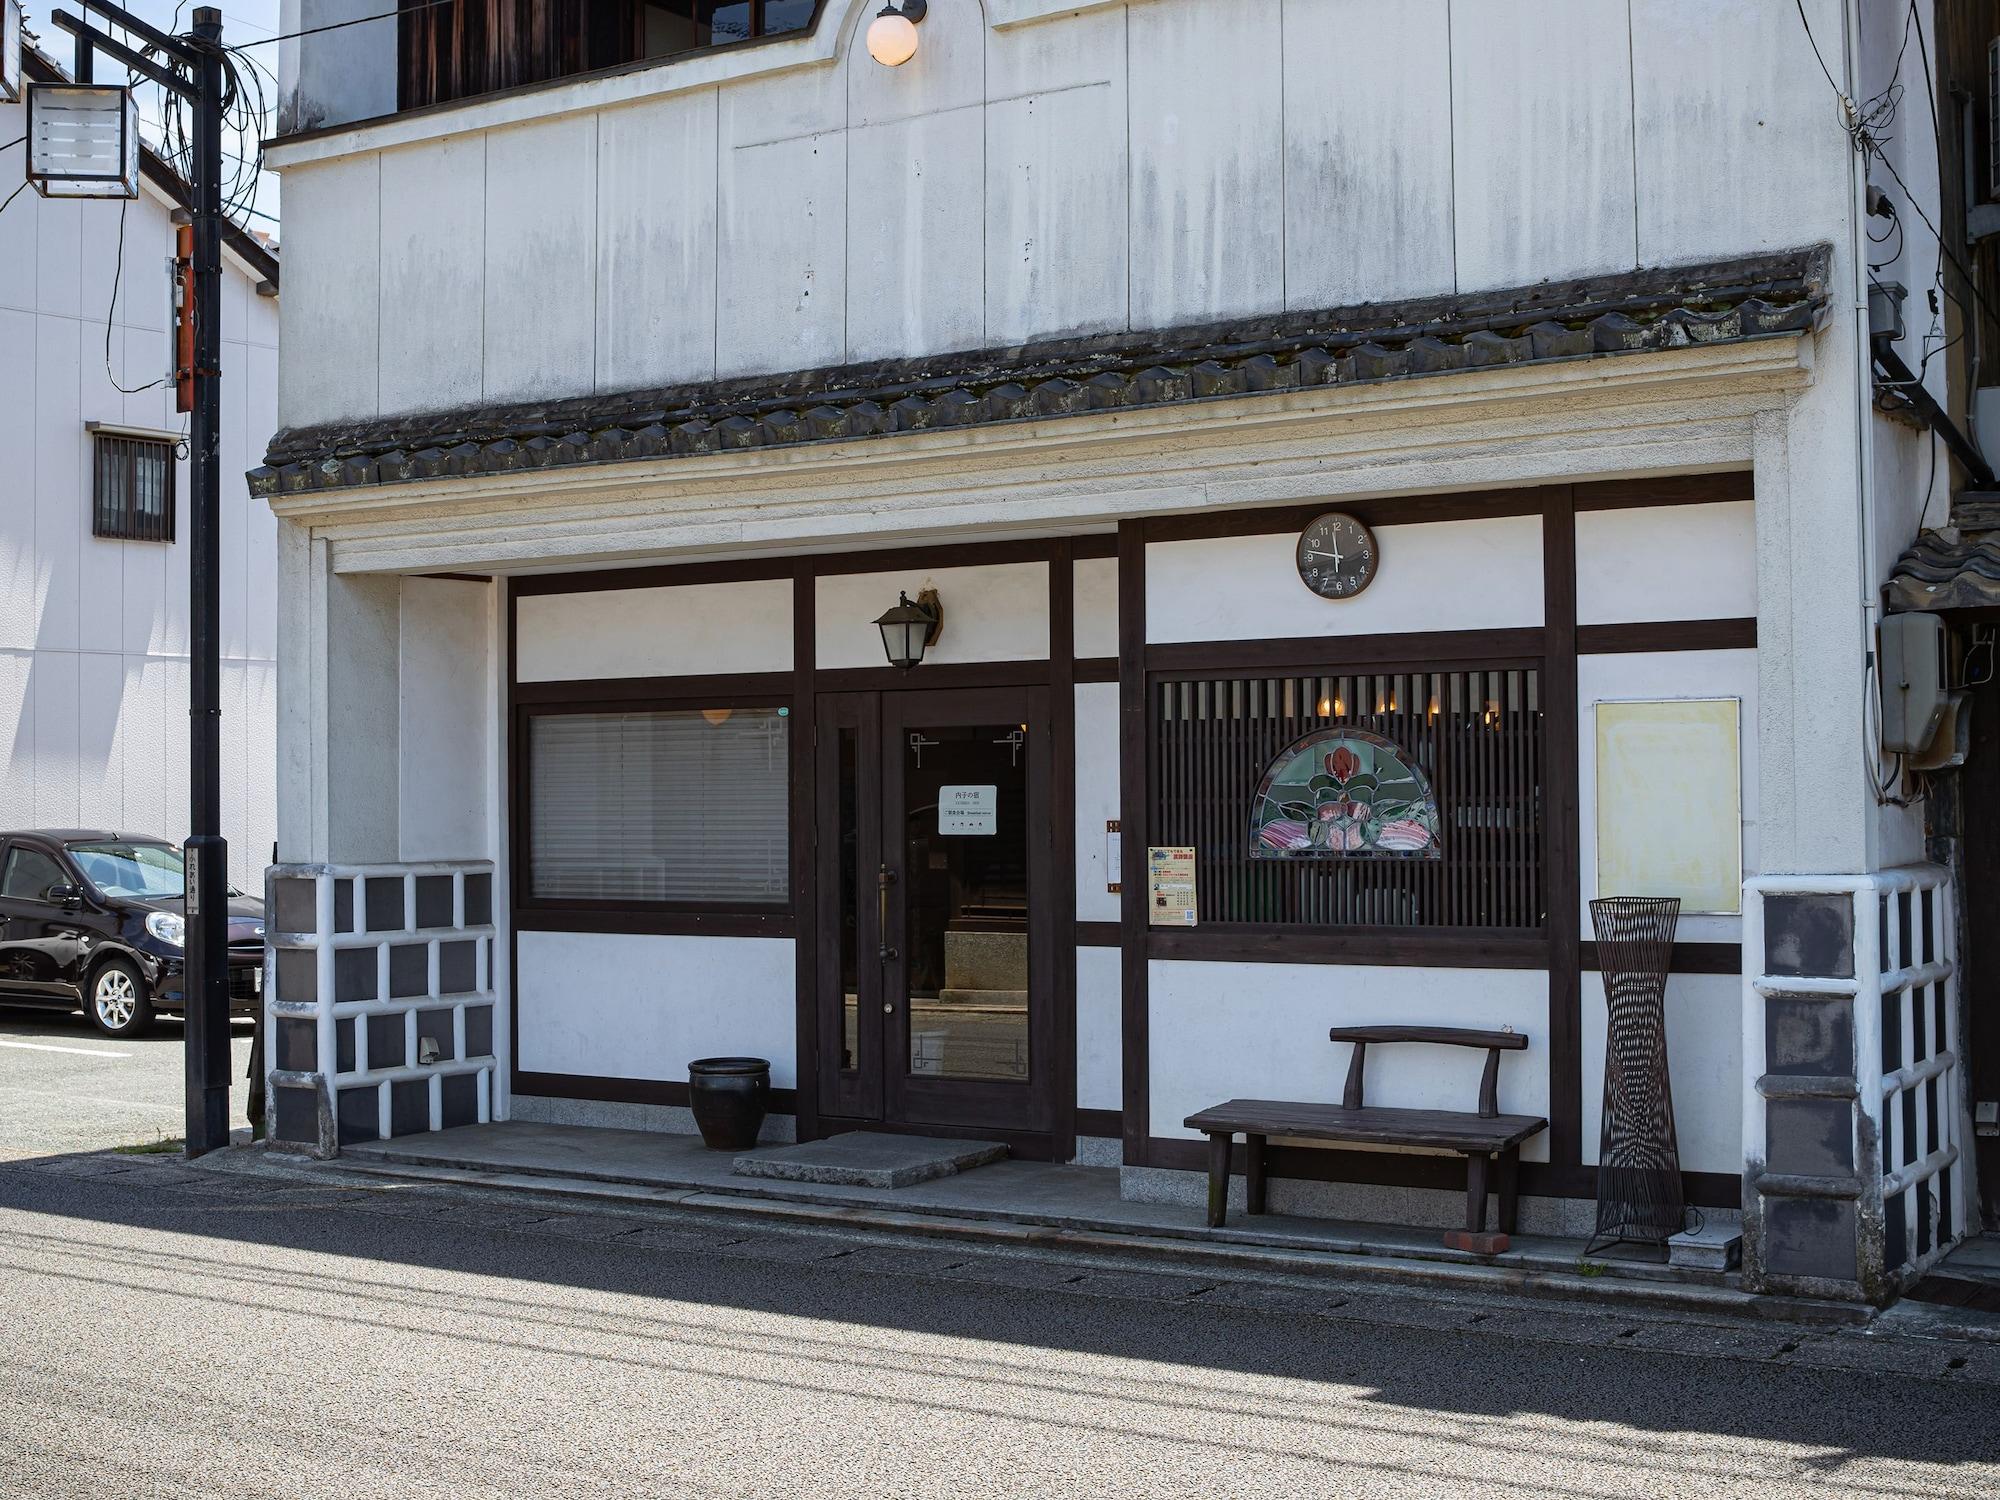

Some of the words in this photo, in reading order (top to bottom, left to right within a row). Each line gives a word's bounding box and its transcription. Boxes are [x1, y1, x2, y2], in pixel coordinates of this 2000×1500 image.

[1333, 522, 1342, 531] 12
[1349, 526, 1353, 534] 1
[1320, 527, 1329, 536] 11
[1311, 539, 1320, 548] 10
[1357, 535, 1364, 544] 2
[1307, 553, 1314, 562] 9
[1362, 550, 1369, 559] 3
[1312, 568, 1319, 577] 8
[1359, 566, 1366, 575] 4
[1322, 578, 1329, 587] 7
[1336, 581, 1343, 591] 6
[1350, 577, 1357, 586] 5
